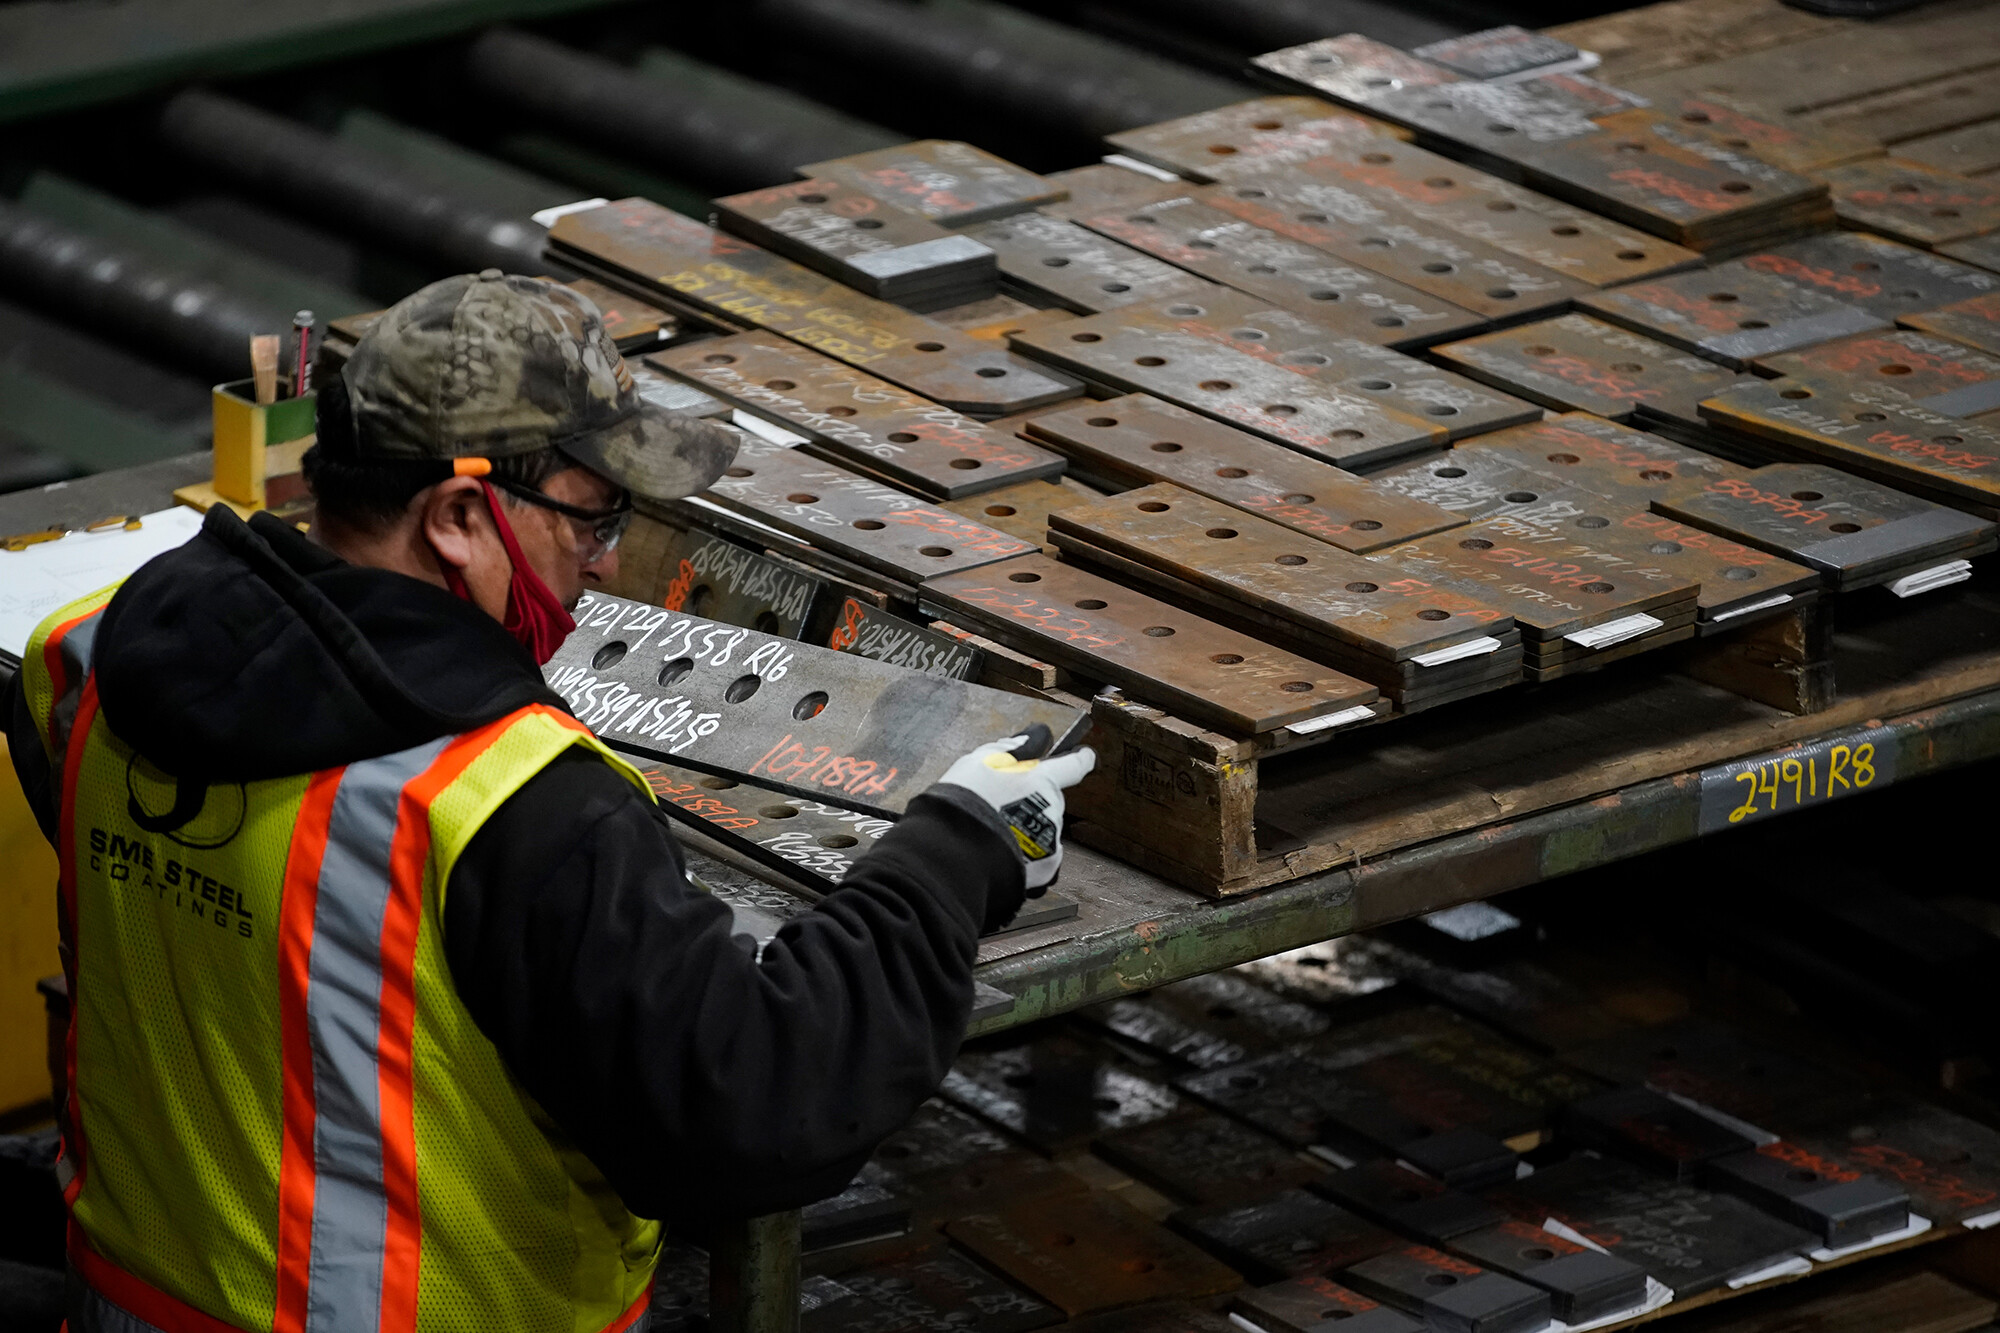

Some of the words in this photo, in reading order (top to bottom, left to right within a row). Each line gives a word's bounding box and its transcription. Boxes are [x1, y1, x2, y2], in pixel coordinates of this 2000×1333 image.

[657, 619, 750, 667] 2558
[742, 641, 795, 683] R16
[748, 734, 898, 796] 107189A
[1727, 762, 1818, 824] 2491
[1826, 743, 1877, 799] R8
[89, 827, 155, 872] SME
[163, 859, 253, 919] STEEL
[89, 854, 253, 939] COATINGS
